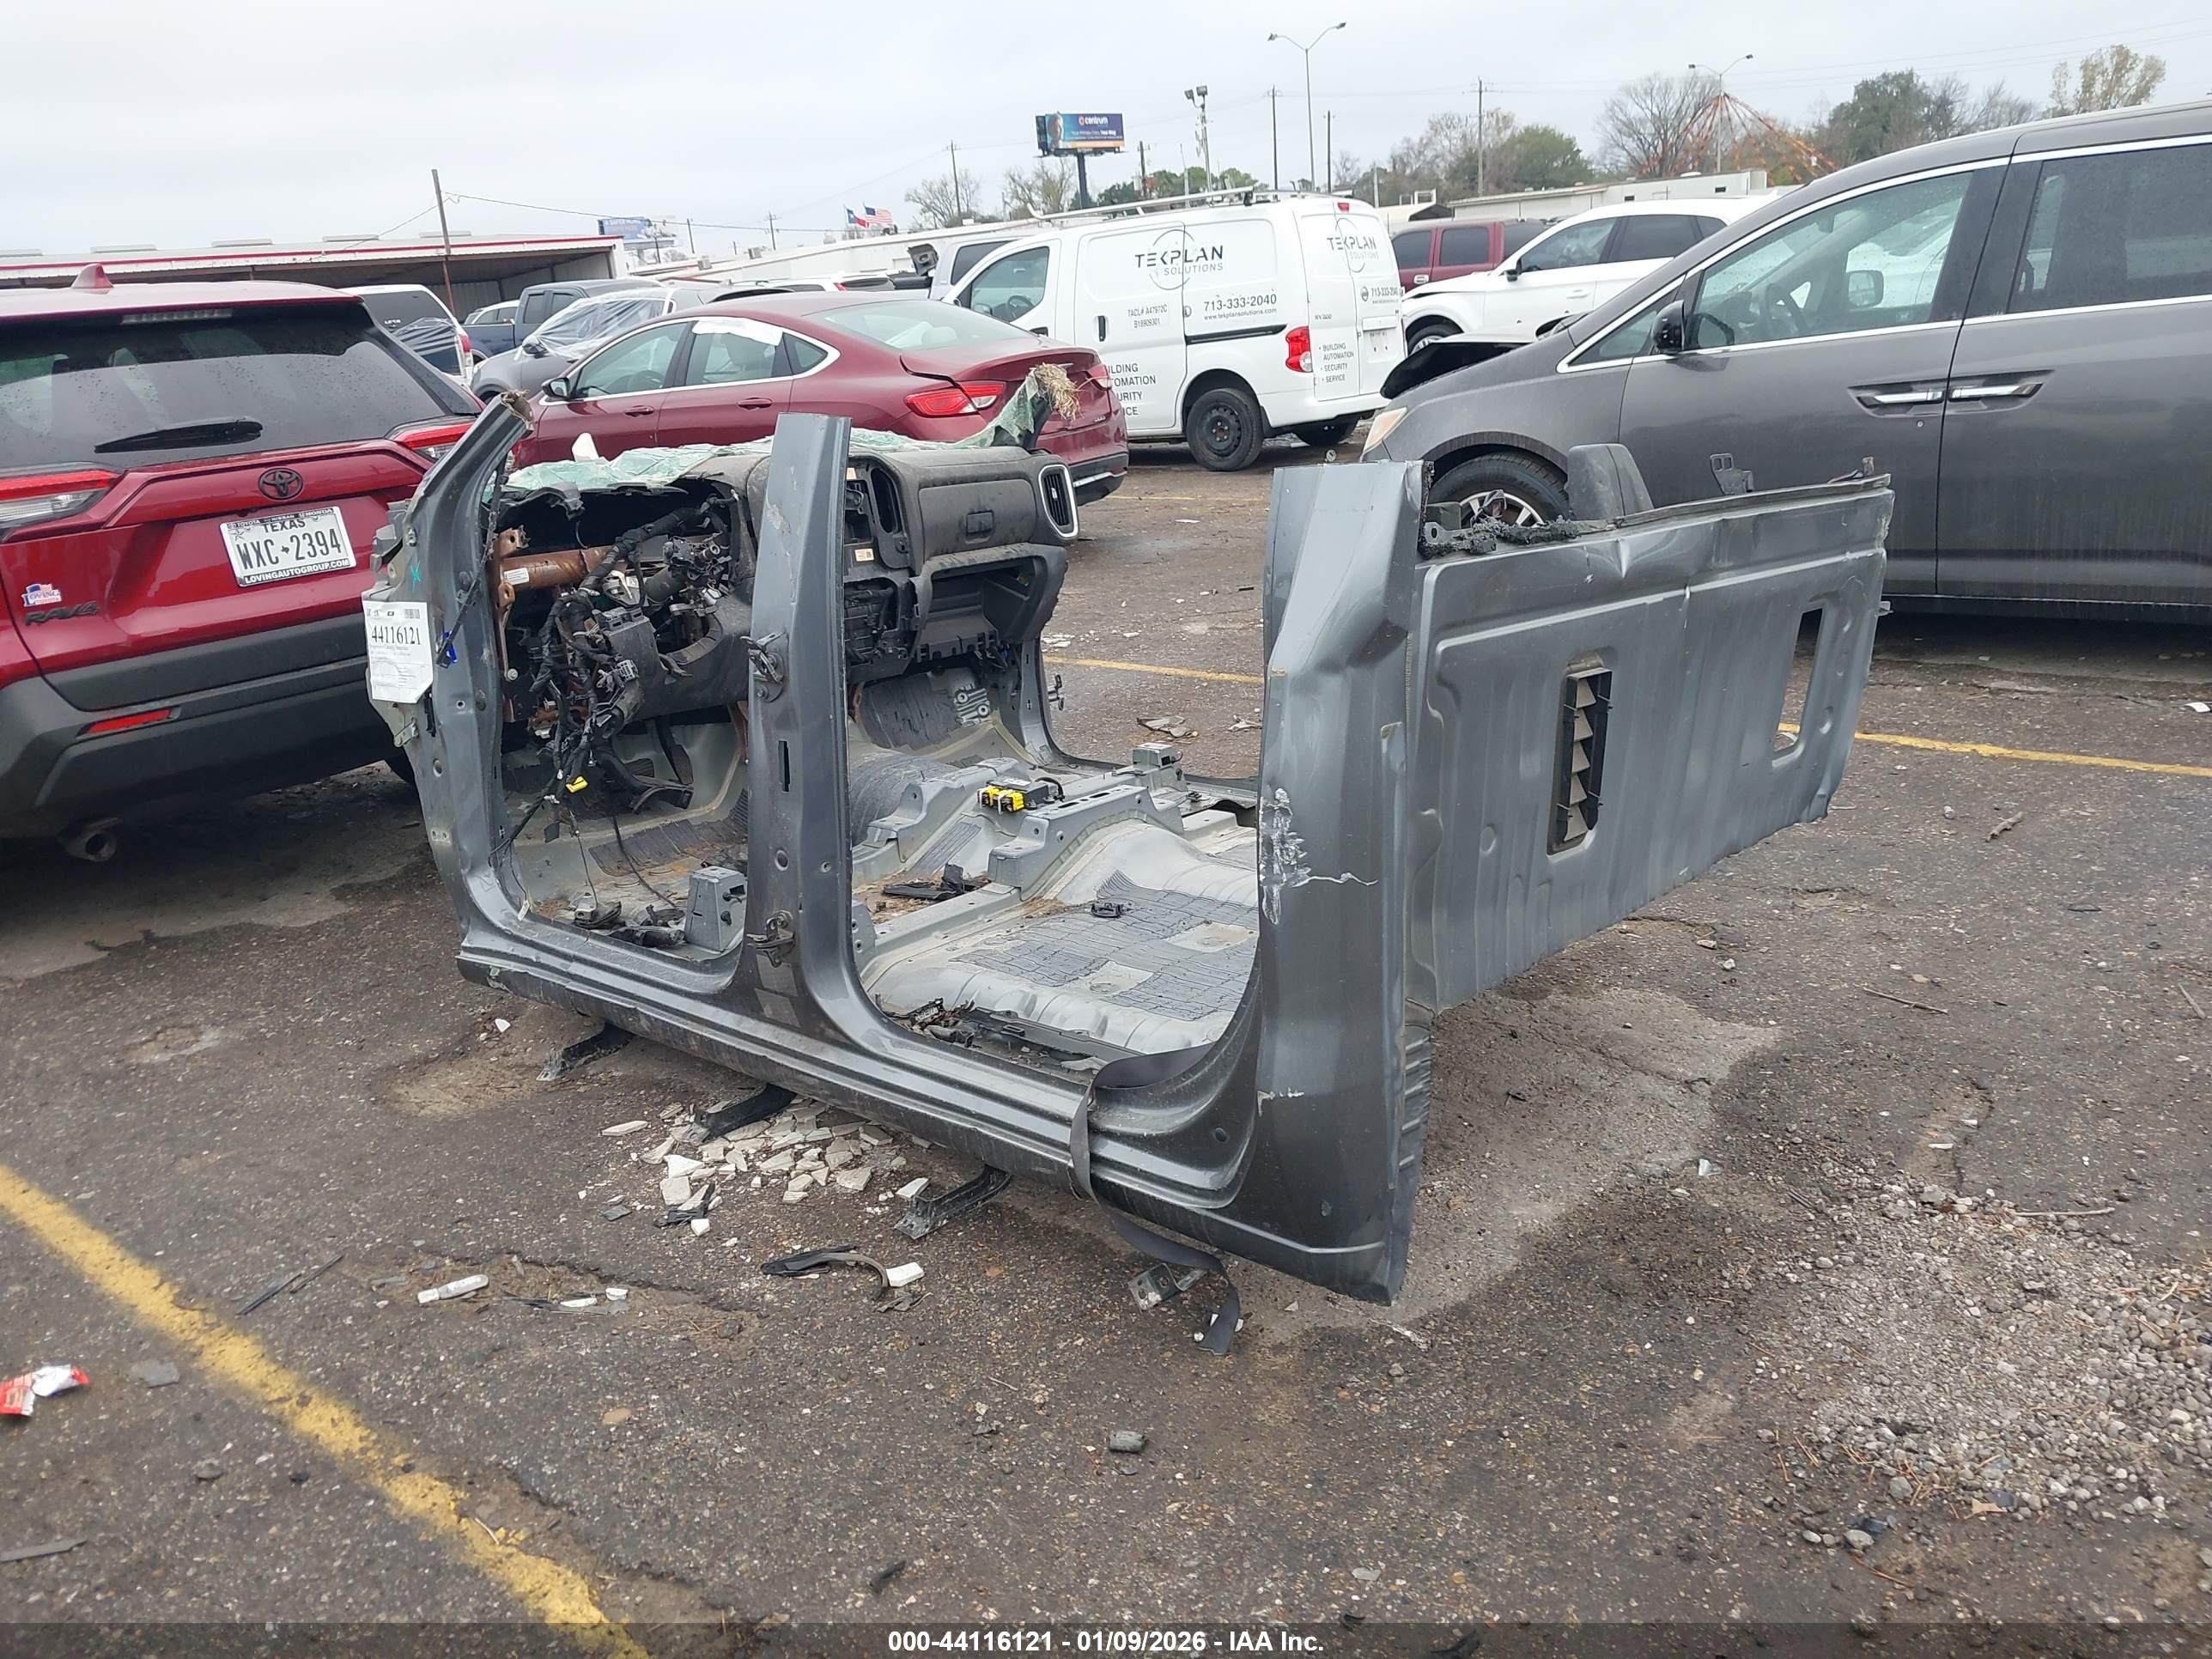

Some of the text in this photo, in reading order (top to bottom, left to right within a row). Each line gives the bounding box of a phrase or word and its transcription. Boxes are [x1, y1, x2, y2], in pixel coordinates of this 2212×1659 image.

[1327, 236, 1376, 251] TEKPLAN
[1134, 246, 1224, 268] TEKPLAN
[1164, 262, 1224, 276] SOLUTIONS
[1204, 294, 1277, 312] 713-333-2040
[1108, 363, 1139, 374] ILDING
[1324, 362, 1348, 372] SECURITY
[1114, 375, 1157, 387] OMATION
[1116, 392, 1143, 402] URITY
[263, 518, 307, 533] TEXAS
[236, 528, 342, 571] WXC 2394
[245, 560, 350, 584] LOVINGAUTOGROUP.COM
[371, 624, 422, 645] 44116121
